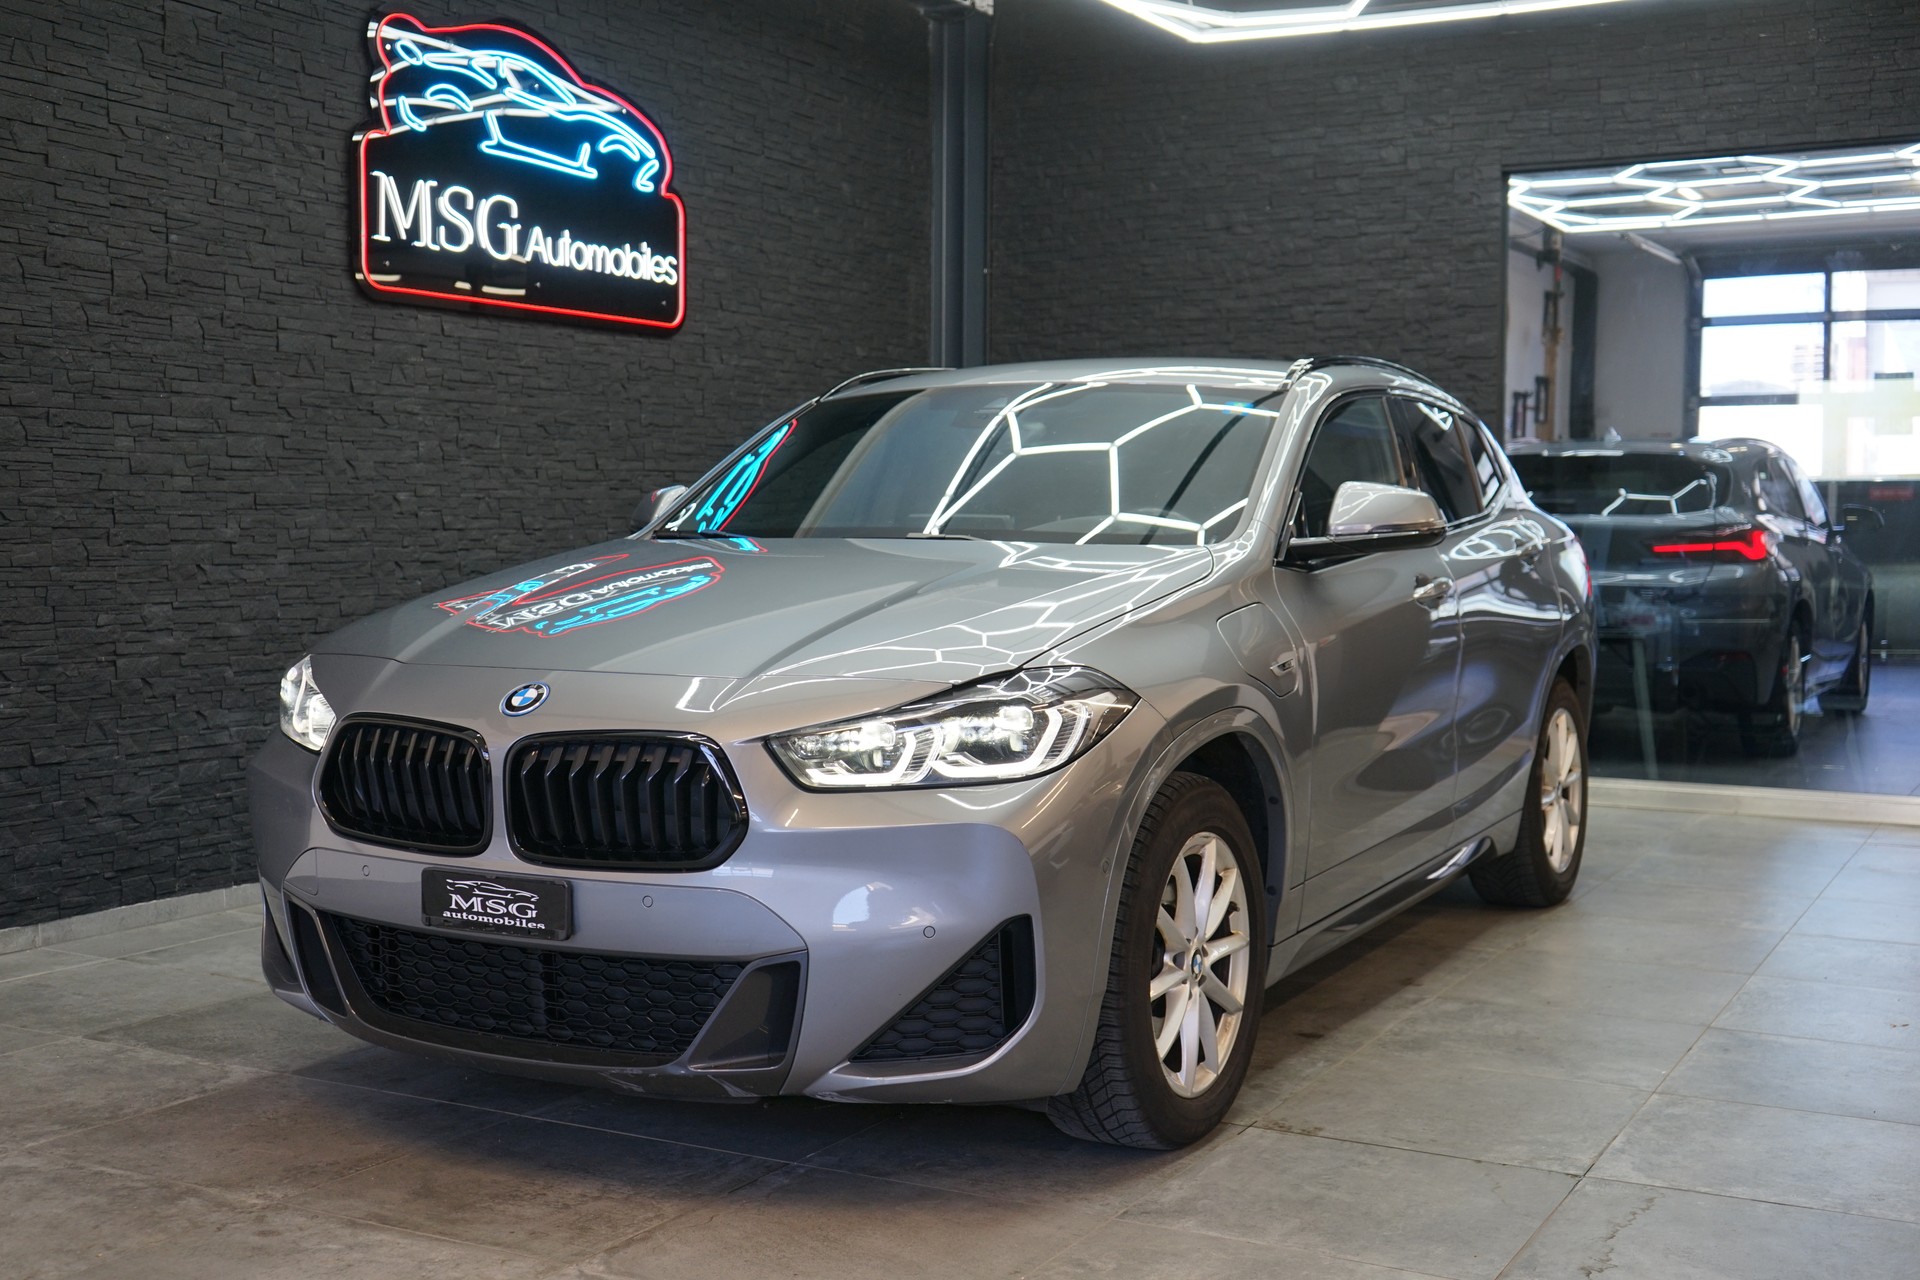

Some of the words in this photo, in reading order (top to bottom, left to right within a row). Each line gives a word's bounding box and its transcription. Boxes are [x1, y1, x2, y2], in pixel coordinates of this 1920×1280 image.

[370, 170, 521, 260] MSG
[525, 226, 678, 285] Automobiles
[449, 894, 538, 918] MSG
[443, 911, 546, 930] automobiles
